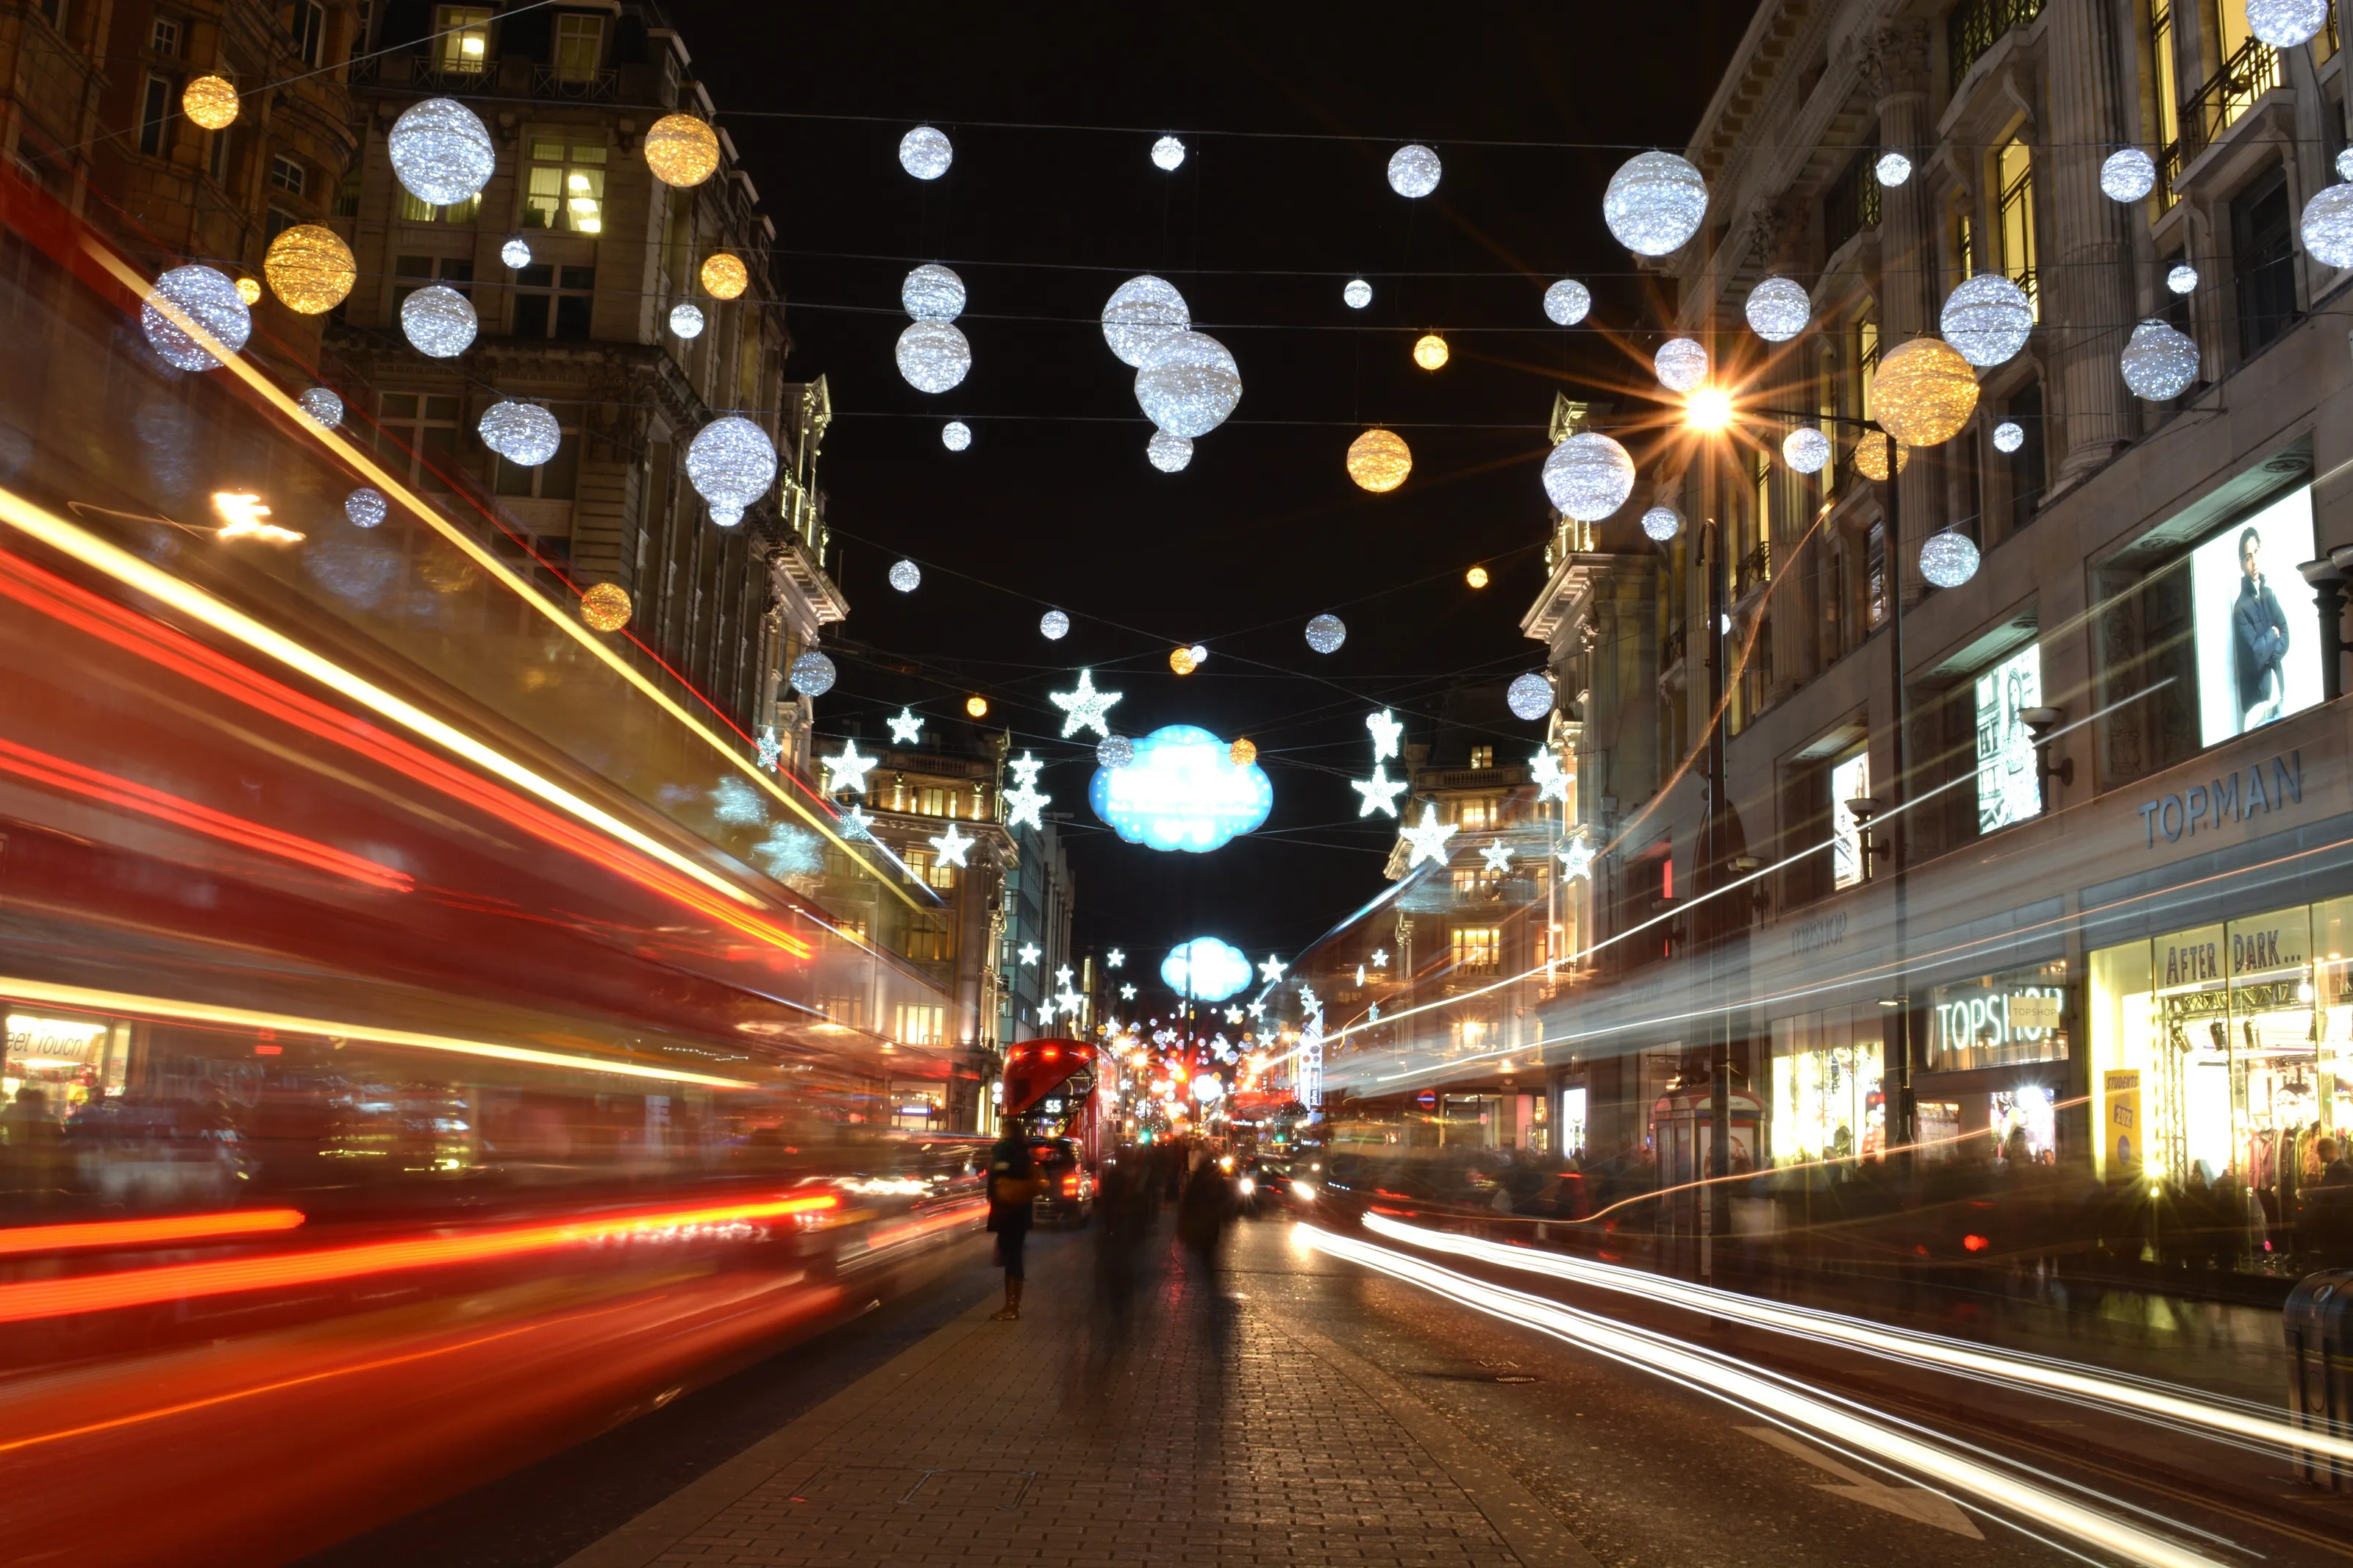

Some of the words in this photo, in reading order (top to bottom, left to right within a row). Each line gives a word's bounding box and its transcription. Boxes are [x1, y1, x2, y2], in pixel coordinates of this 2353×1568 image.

[2138, 750, 2302, 849] TOPMAN
[1791, 911, 1847, 958] TOPSHOP
[2166, 942, 2218, 985] AFTER
[2013, 1007, 2057, 1017] TOPSHOP
[2107, 1075, 2139, 1090] STUDENTS
[1045, 1100, 1062, 1113] 55
[1310, 1089, 1319, 1106] John
[2115, 1107, 2132, 1128] 20%
